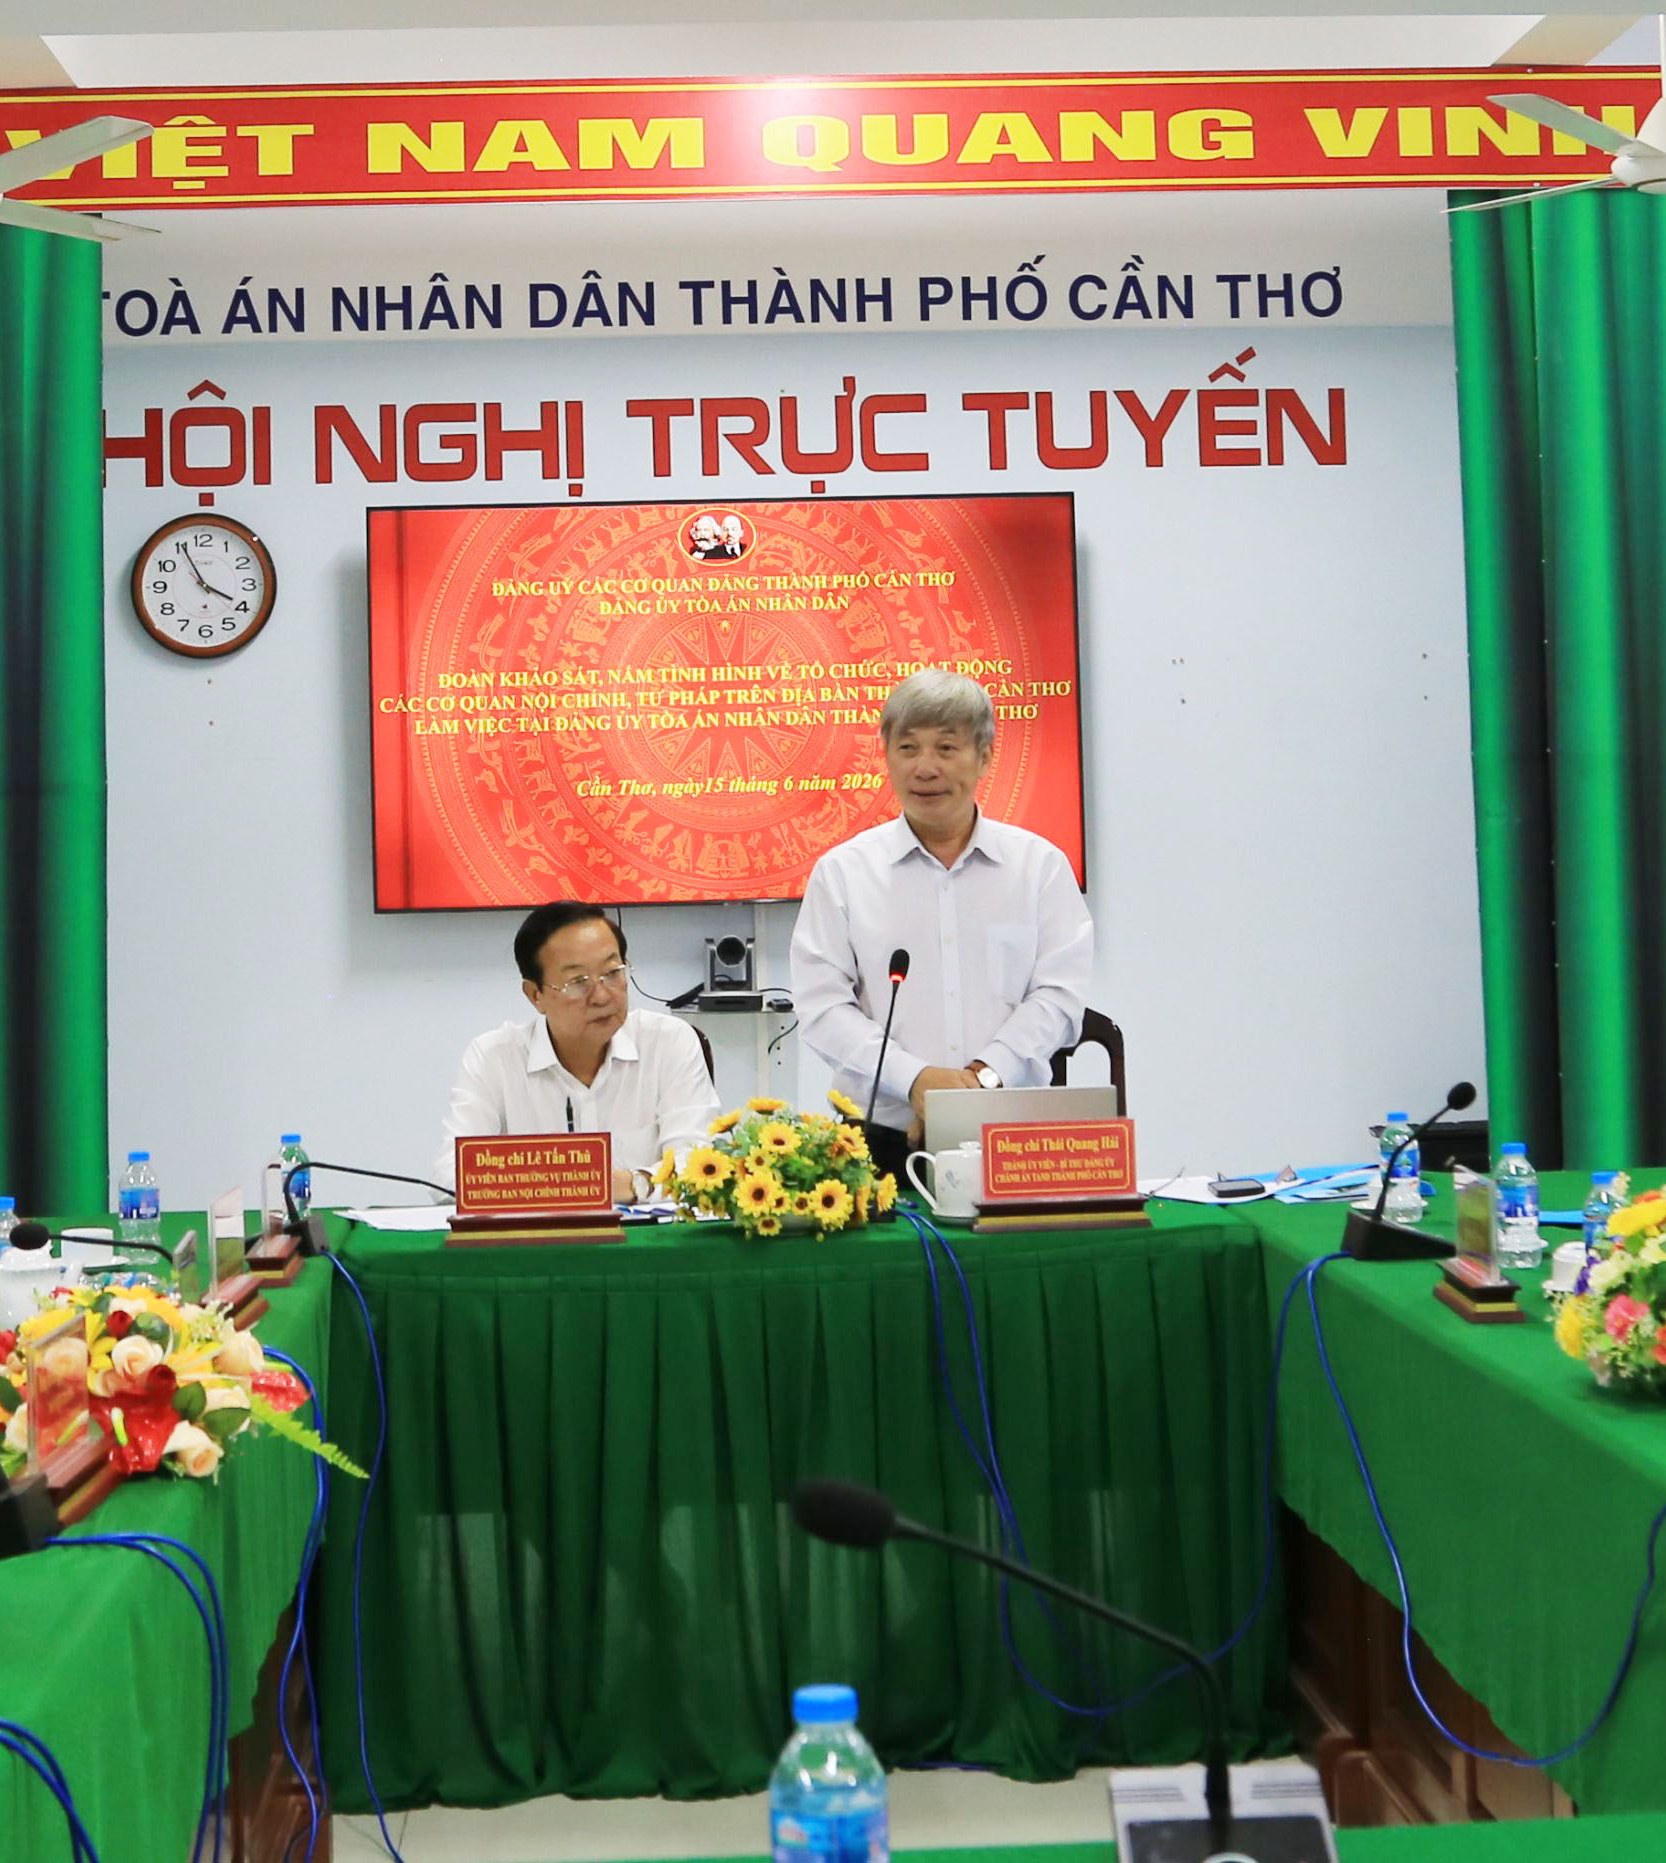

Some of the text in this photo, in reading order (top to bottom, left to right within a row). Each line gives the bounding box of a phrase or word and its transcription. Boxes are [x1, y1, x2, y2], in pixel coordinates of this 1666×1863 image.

[367, 116, 705, 173] NAM
[762, 107, 1254, 173] QUANG
[102, 255, 1342, 337] OÀ ÁN NHÂN DÂN THÀNH PHỐ CẦN THƠ
[102, 350, 1345, 507] HỘI NGHỊ TRỰC TUYẾN
[174, 541, 188, 554] 11
[193, 533, 213, 548] 12
[223, 540, 229, 553] 1
[157, 559, 177, 573] 10
[235, 556, 251, 570] 2
[152, 580, 168, 594] 9
[241, 577, 257, 592] 3
[492, 578, 544, 596] ĐẢNG
[578, 576, 617, 595] CÁC
[620, 577, 649, 594] CƠ
[651, 577, 703, 596] QUAN
[707, 573, 759, 591] ĐẢNG
[762, 572, 827, 590] THÀNH
[832, 570, 870, 589] PHỐ
[873, 569, 911, 587] CẦN
[915, 571, 955, 586] THƠ
[160, 602, 175, 616] 8
[234, 600, 251, 614] 4
[599, 591, 849, 616] ĐẢNG ỦY TÒA ÁN NHÂN DÂN
[177, 618, 190, 632] 7
[197, 624, 214, 639] 6
[221, 617, 237, 632] 5
[438, 669, 494, 689] ĐOÀN
[500, 666, 558, 687] KHẢO
[562, 666, 604, 687] SÁT,
[657, 663, 706, 683] TÌNH
[711, 662, 761, 682] HÌNH
[828, 659, 892, 679] CHỨC,
[956, 659, 1013, 679] ĐỘNG
[379, 693, 421, 713] CÁC
[426, 695, 456, 712] CƠ
[459, 695, 515, 714] QUAN
[521, 692, 556, 713] NỘI
[561, 688, 632, 709] CHÍNH,
[635, 689, 665, 707] TƯ
[668, 686, 721, 706] PHÁP
[723, 684, 776, 705] TRÊN
[781, 687, 817, 709] ĐỊA
[819, 682, 859, 702] BÀN
[1030, 680, 1071, 697] THƠ
[415, 704, 1038, 737] LÀM VIỆC TẠI ĐẢNG ỦY TÒA ÁN NHÂN DÂN THÀN THƠ
[619, 779, 657, 797] Thơ,
[728, 775, 779, 796] tháng
[783, 775, 794, 791] 6
[798, 775, 836, 791] năm
[841, 773, 882, 790] 2026
